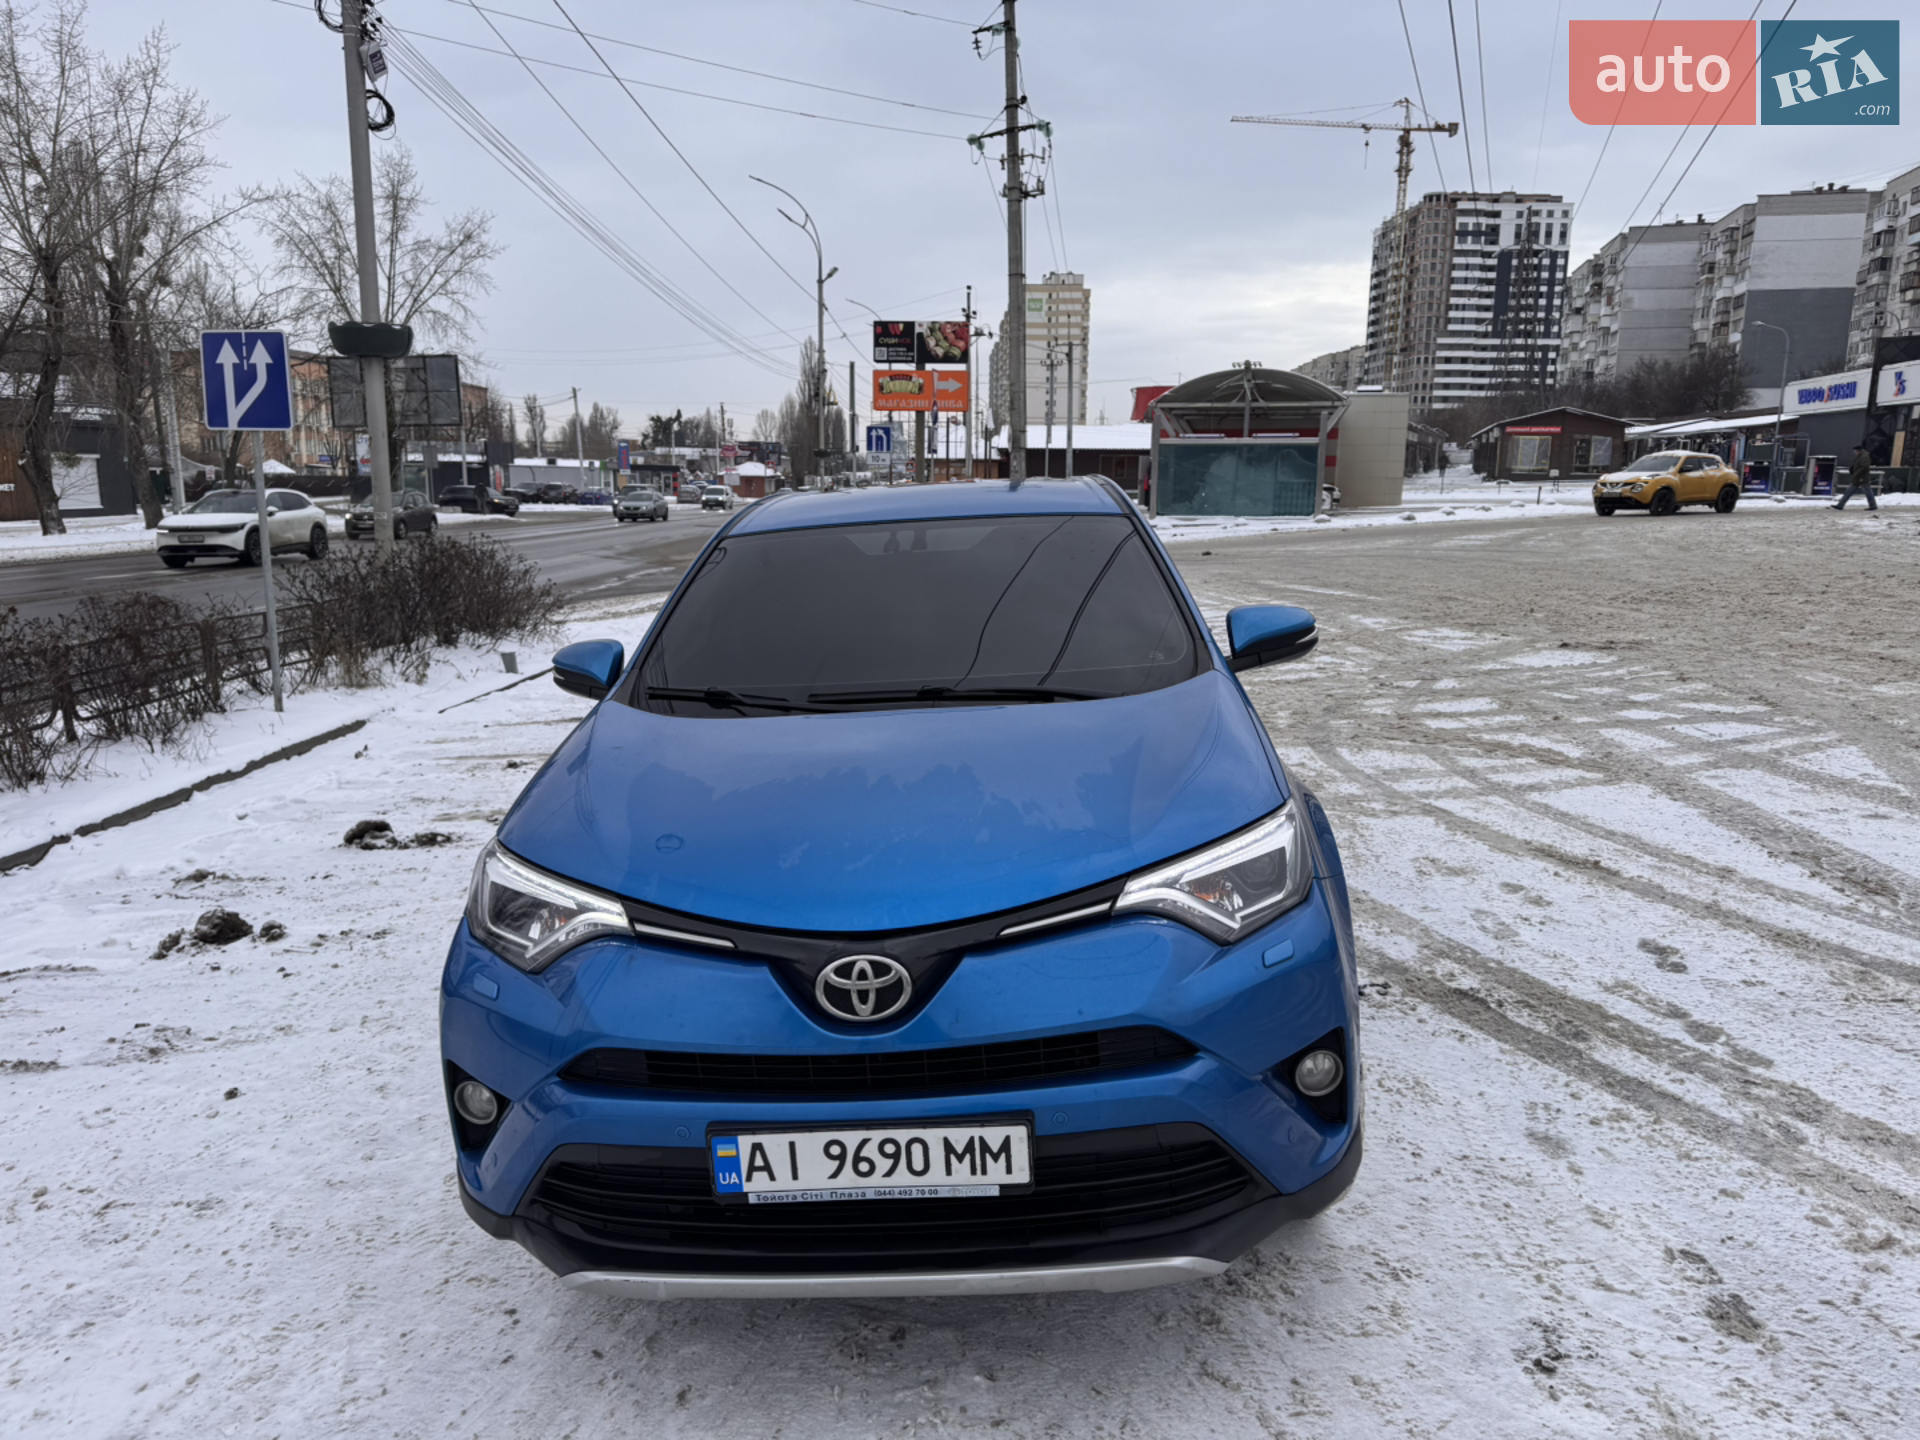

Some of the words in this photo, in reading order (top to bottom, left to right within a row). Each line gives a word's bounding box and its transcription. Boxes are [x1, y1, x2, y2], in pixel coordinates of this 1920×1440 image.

[876, 399, 929, 409] МАГАЗИН
[871, 455, 880, 463] 10
[745, 1140, 799, 1183] AI
[822, 1136, 931, 1179] 9690
[942, 1134, 1013, 1177] MM
[719, 1172, 740, 1185] UA
[755, 1194, 798, 1202] Тойота
[800, 1191, 824, 1201] Сіті
[830, 1191, 867, 1200] Плаза
[874, 1188, 895, 1198] (044)
[897, 1188, 913, 1197] 492
[915, 1188, 926, 1197] 70
[927, 1188, 938, 1197] 00
